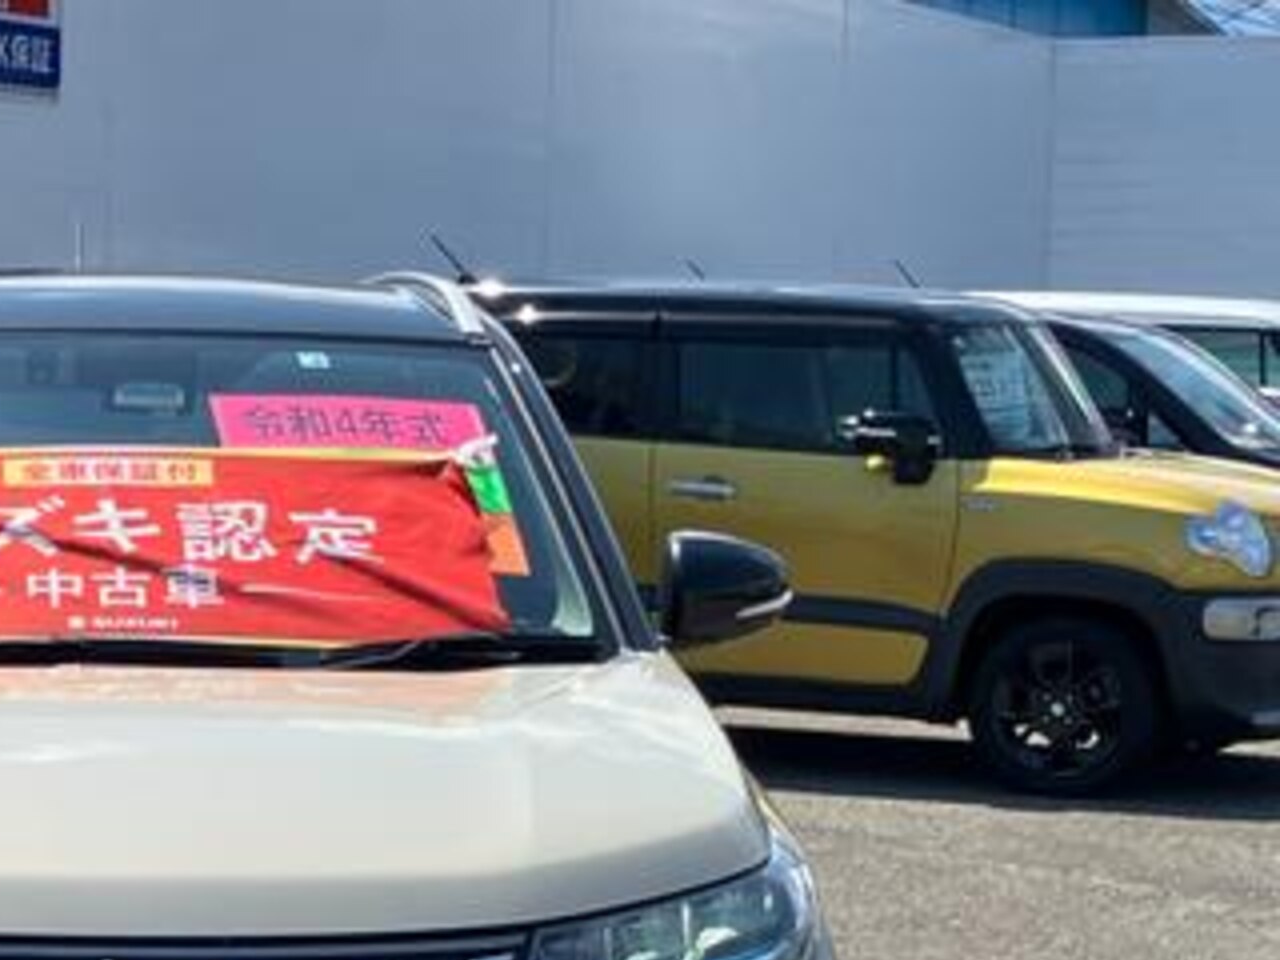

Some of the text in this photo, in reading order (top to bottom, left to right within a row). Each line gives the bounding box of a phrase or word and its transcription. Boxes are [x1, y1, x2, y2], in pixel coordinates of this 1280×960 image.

[246, 405, 451, 444] 令和4年式
[26, 567, 224, 608] 中古車
